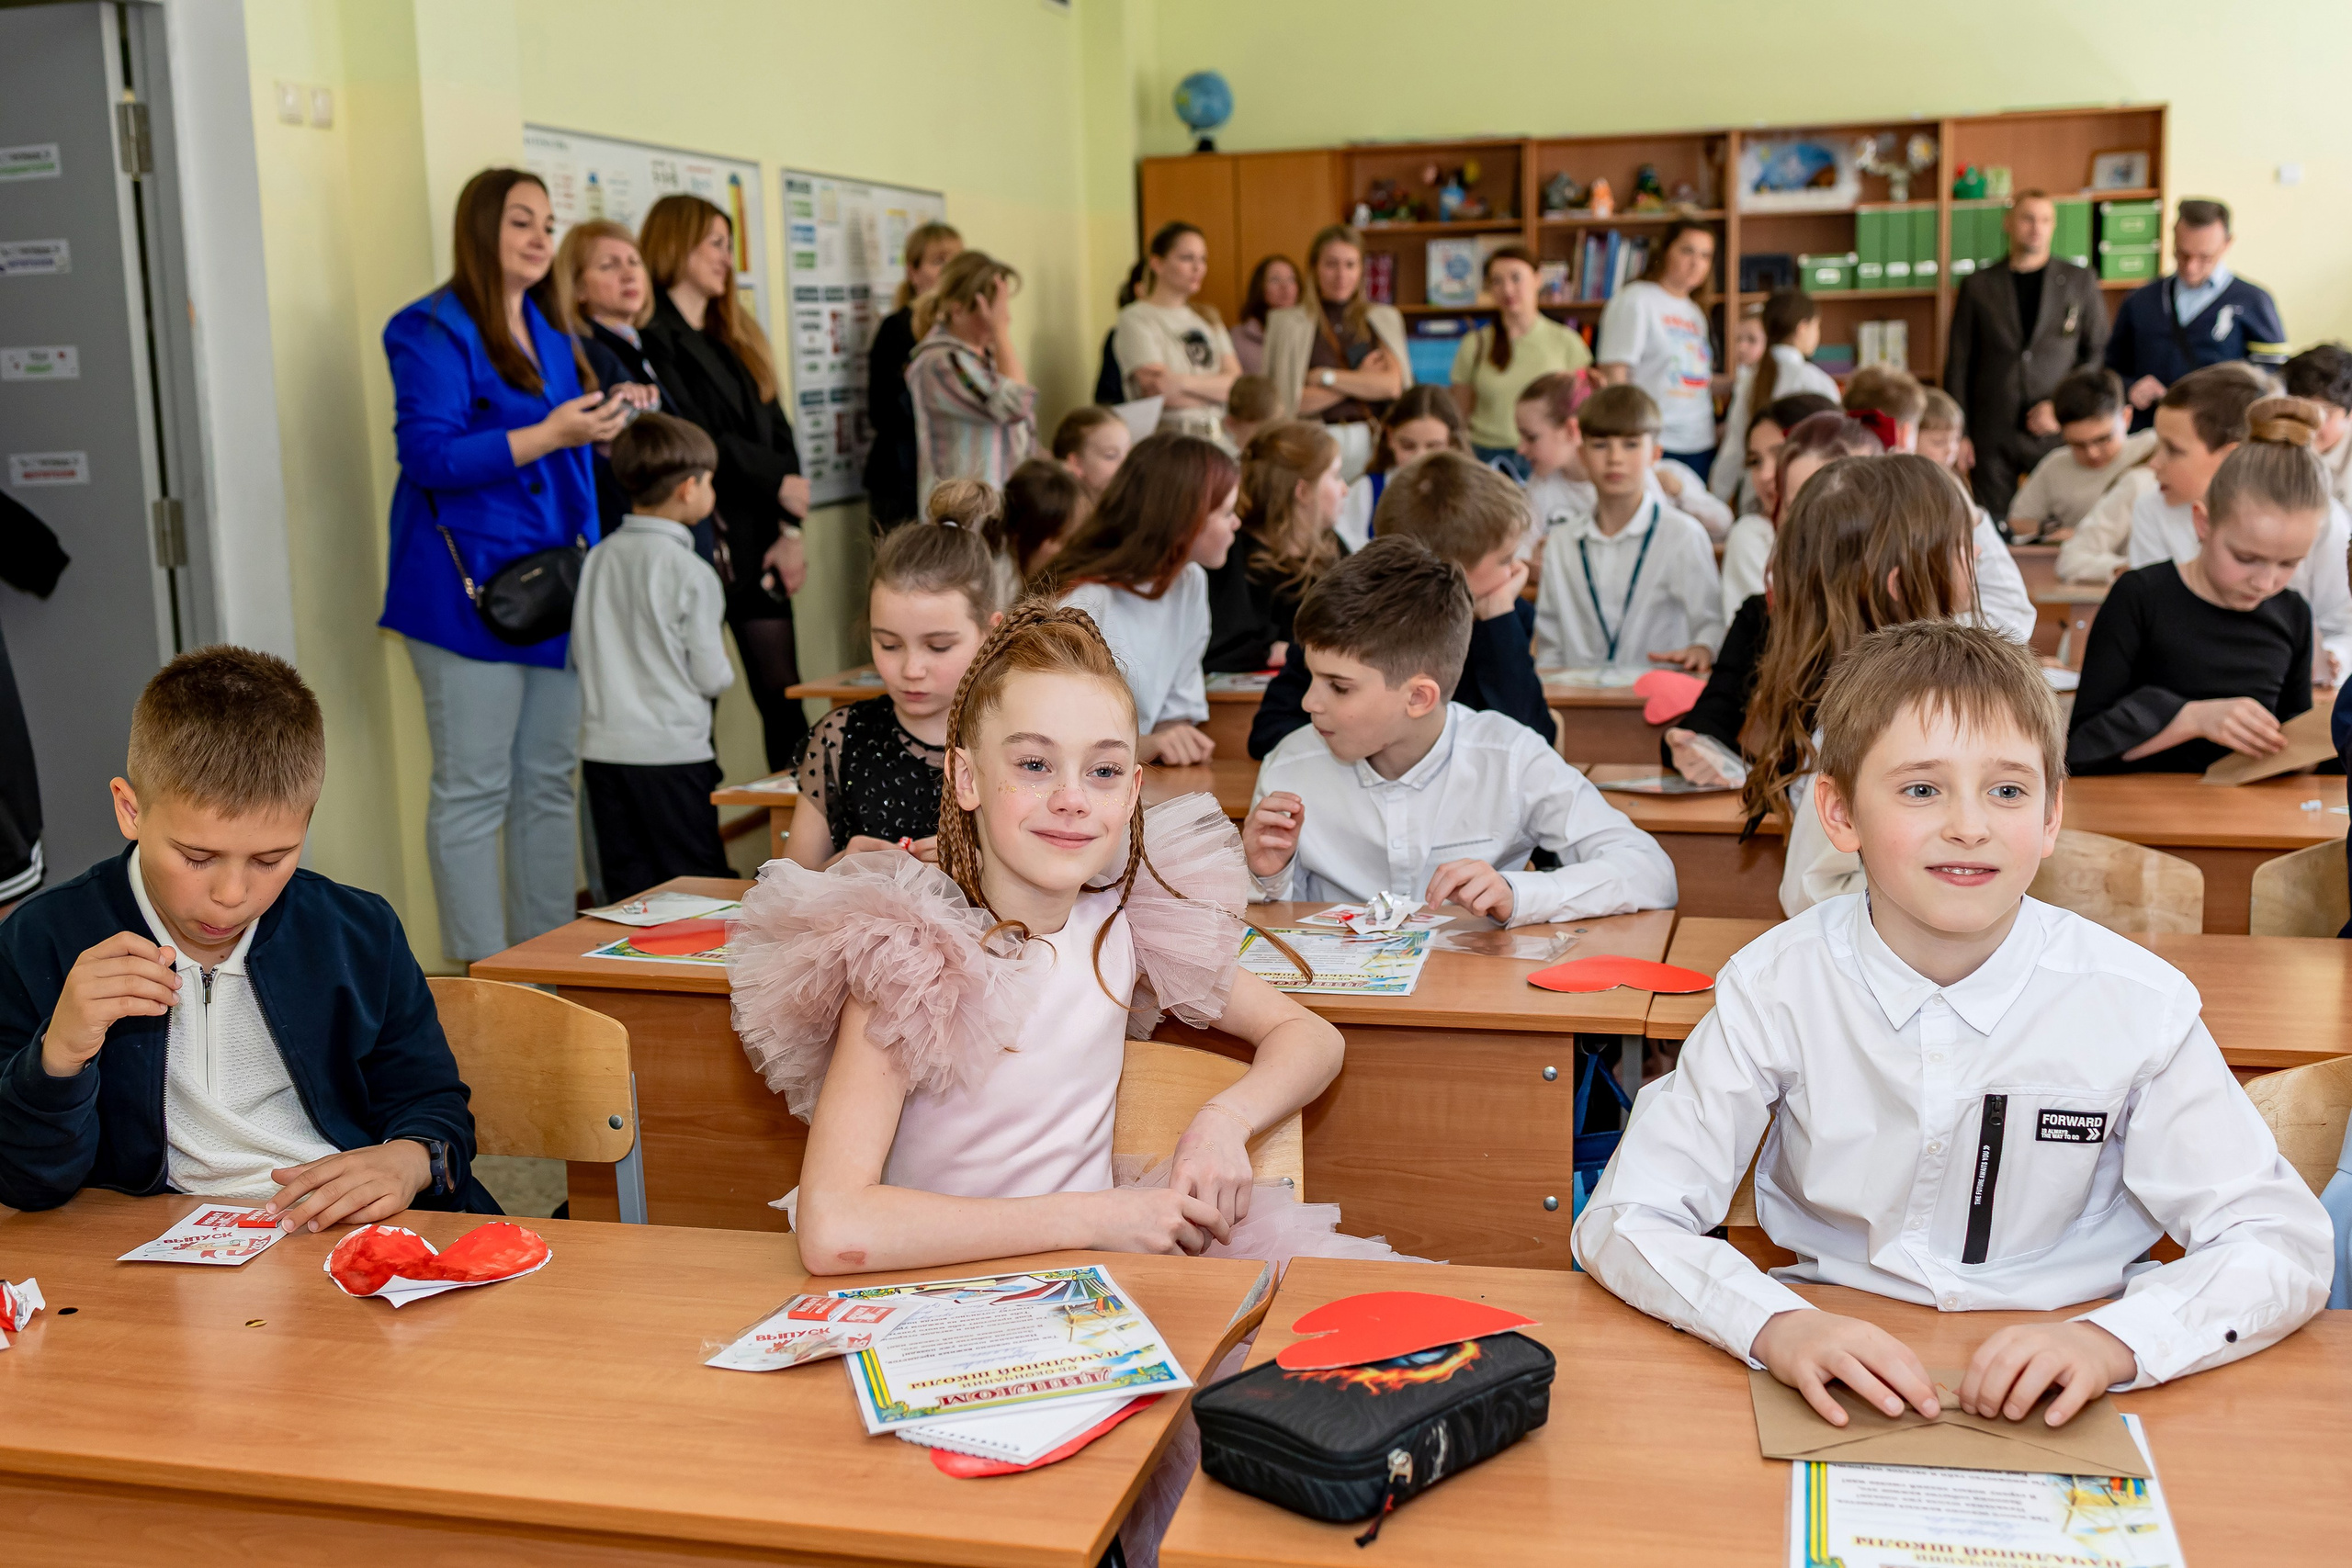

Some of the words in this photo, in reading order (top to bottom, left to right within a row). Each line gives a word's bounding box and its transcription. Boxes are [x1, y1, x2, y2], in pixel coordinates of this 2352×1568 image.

[2042, 1113, 2103, 1128] FORWARD
[1982, 1150, 1990, 1161] YOU
[1979, 1161, 1988, 1179] AWAITS
[163, 1232, 233, 1244] ВЫПУСК
[756, 1327, 831, 1342] ВЫПУСК
[996, 1350, 1121, 1375] НАЧАЛЬНОЙ
[910, 1371, 990, 1389] ШКОЛЫ
[933, 1366, 1116, 1407] ДИПЛОМ
[961, 1369, 1055, 1388] ОКОНЧАНИИ
[1855, 1536, 1953, 1553] ШКОЛЫ
[1962, 1545, 2122, 1568] НАЧАЛЬНОЙ
